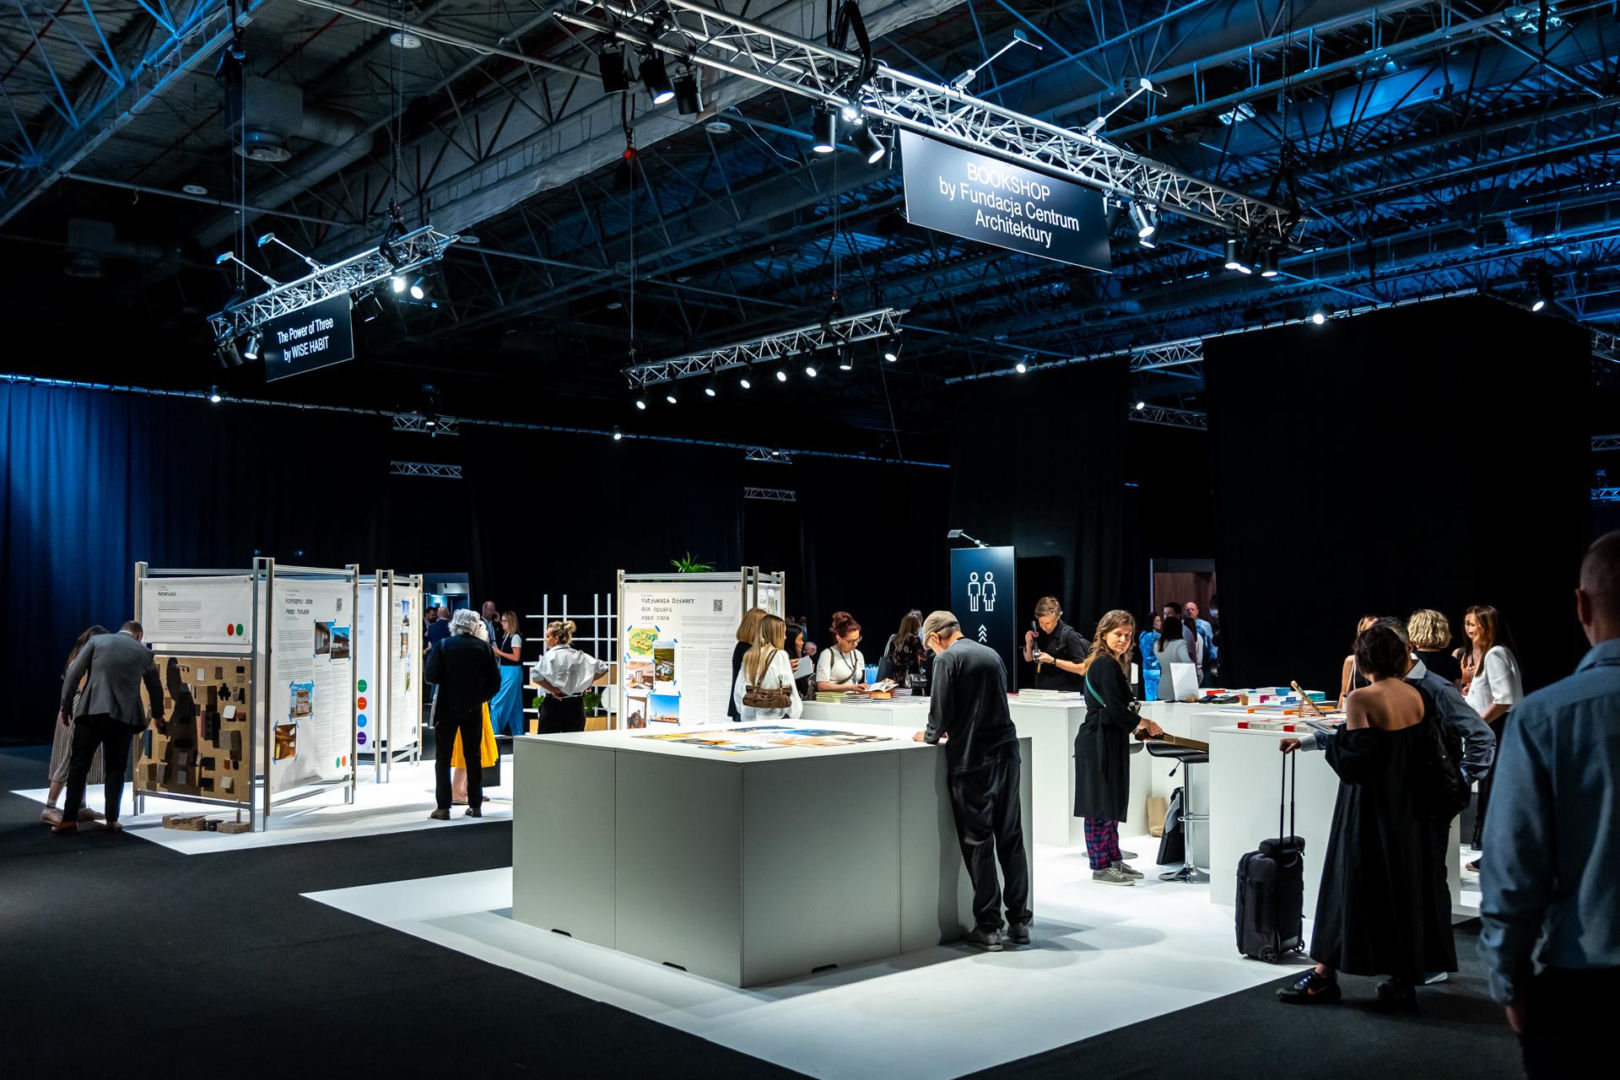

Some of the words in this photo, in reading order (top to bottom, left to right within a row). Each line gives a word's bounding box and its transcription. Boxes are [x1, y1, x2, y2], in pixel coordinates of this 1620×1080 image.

[967, 162, 1050, 202] BOOKSHOP
[939, 175, 956, 201] by
[960, 183, 1023, 217] Fundacja
[1025, 202, 1080, 232] Centrum
[975, 209, 1052, 248] Architektury
[277, 331, 289, 344] The
[289, 326, 308, 341] Power
[308, 320, 315, 335] of
[315, 318, 334, 332] Three
[283, 348, 291, 363] by
[291, 342, 309, 359] WISE
[309, 335, 329, 353] HABIT
